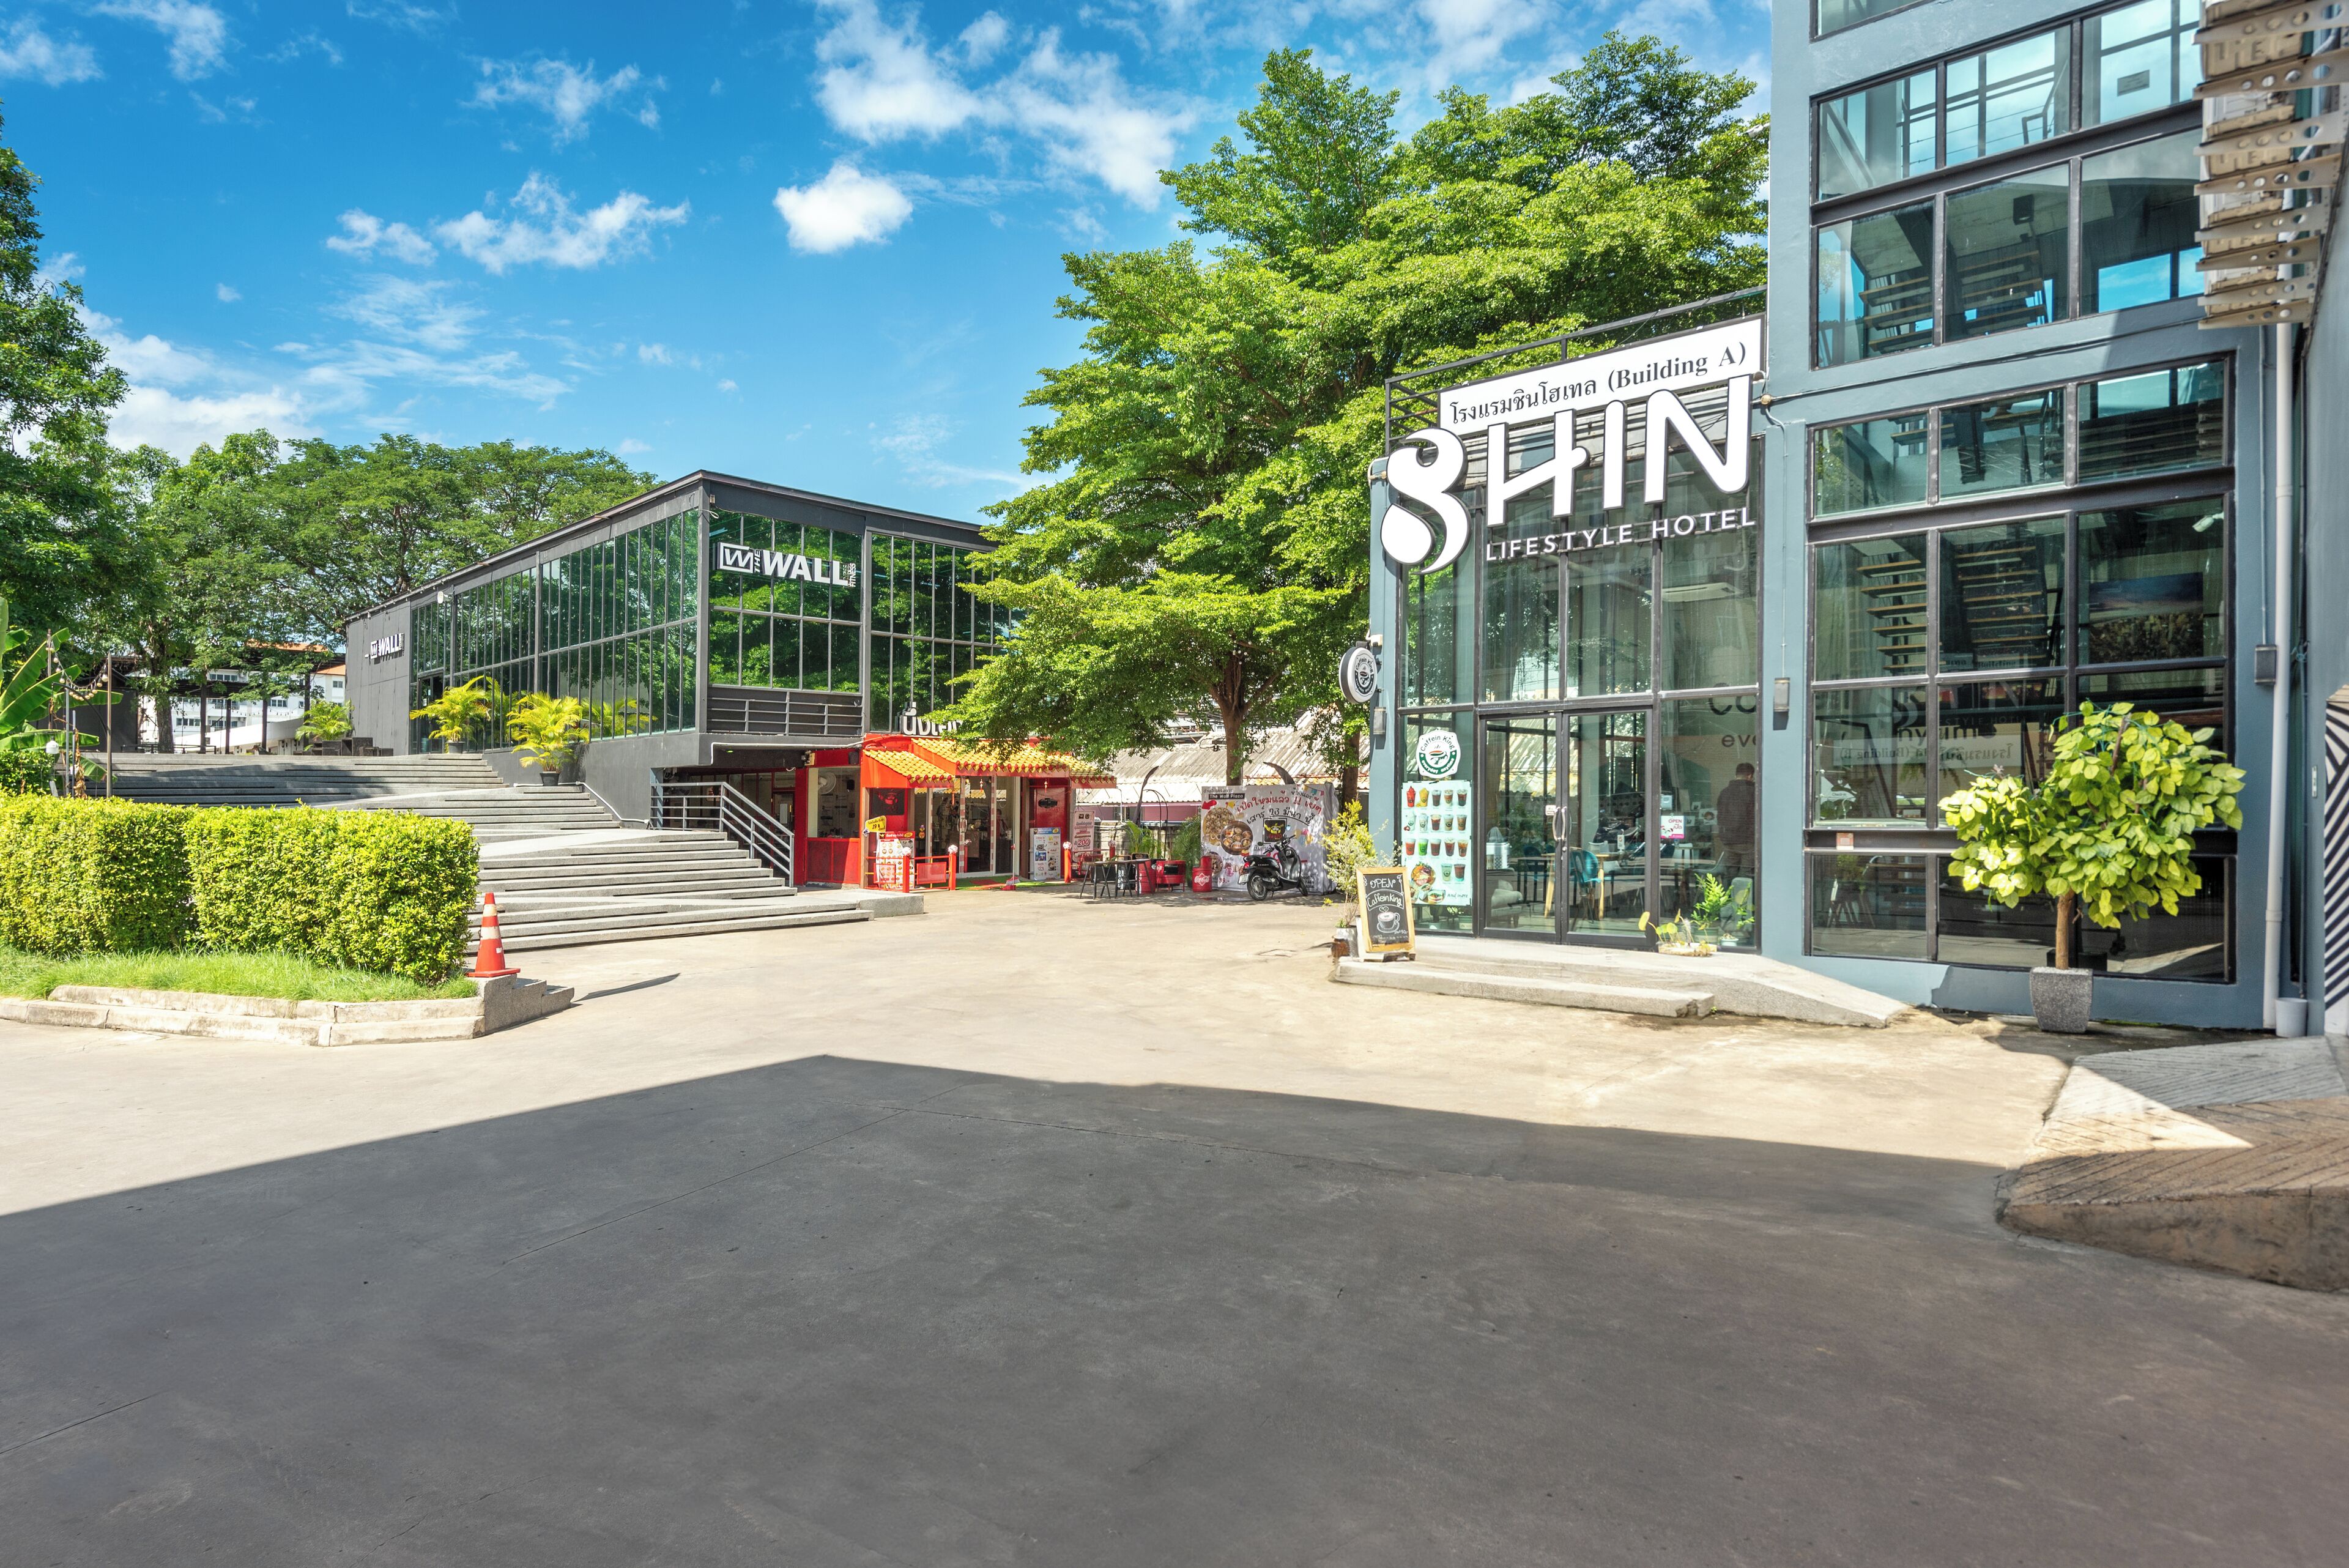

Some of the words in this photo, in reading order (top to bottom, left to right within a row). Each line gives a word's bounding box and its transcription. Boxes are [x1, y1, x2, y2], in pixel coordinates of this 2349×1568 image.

[1449, 378, 1597, 424] โรงแรมชินโฮเทล
[1608, 356, 1709, 392] (Building
[1718, 341, 1746, 367] A)
[1486, 523, 1634, 562] LIFESTYLE
[1652, 507, 1756, 539] HOTEL
[762, 549, 848, 586] WALL
[378, 634, 399, 656] WALL
[1420, 735, 1441, 751] Caffein
[1442, 735, 1455, 750] King
[1370, 878, 1396, 889] OPEN
